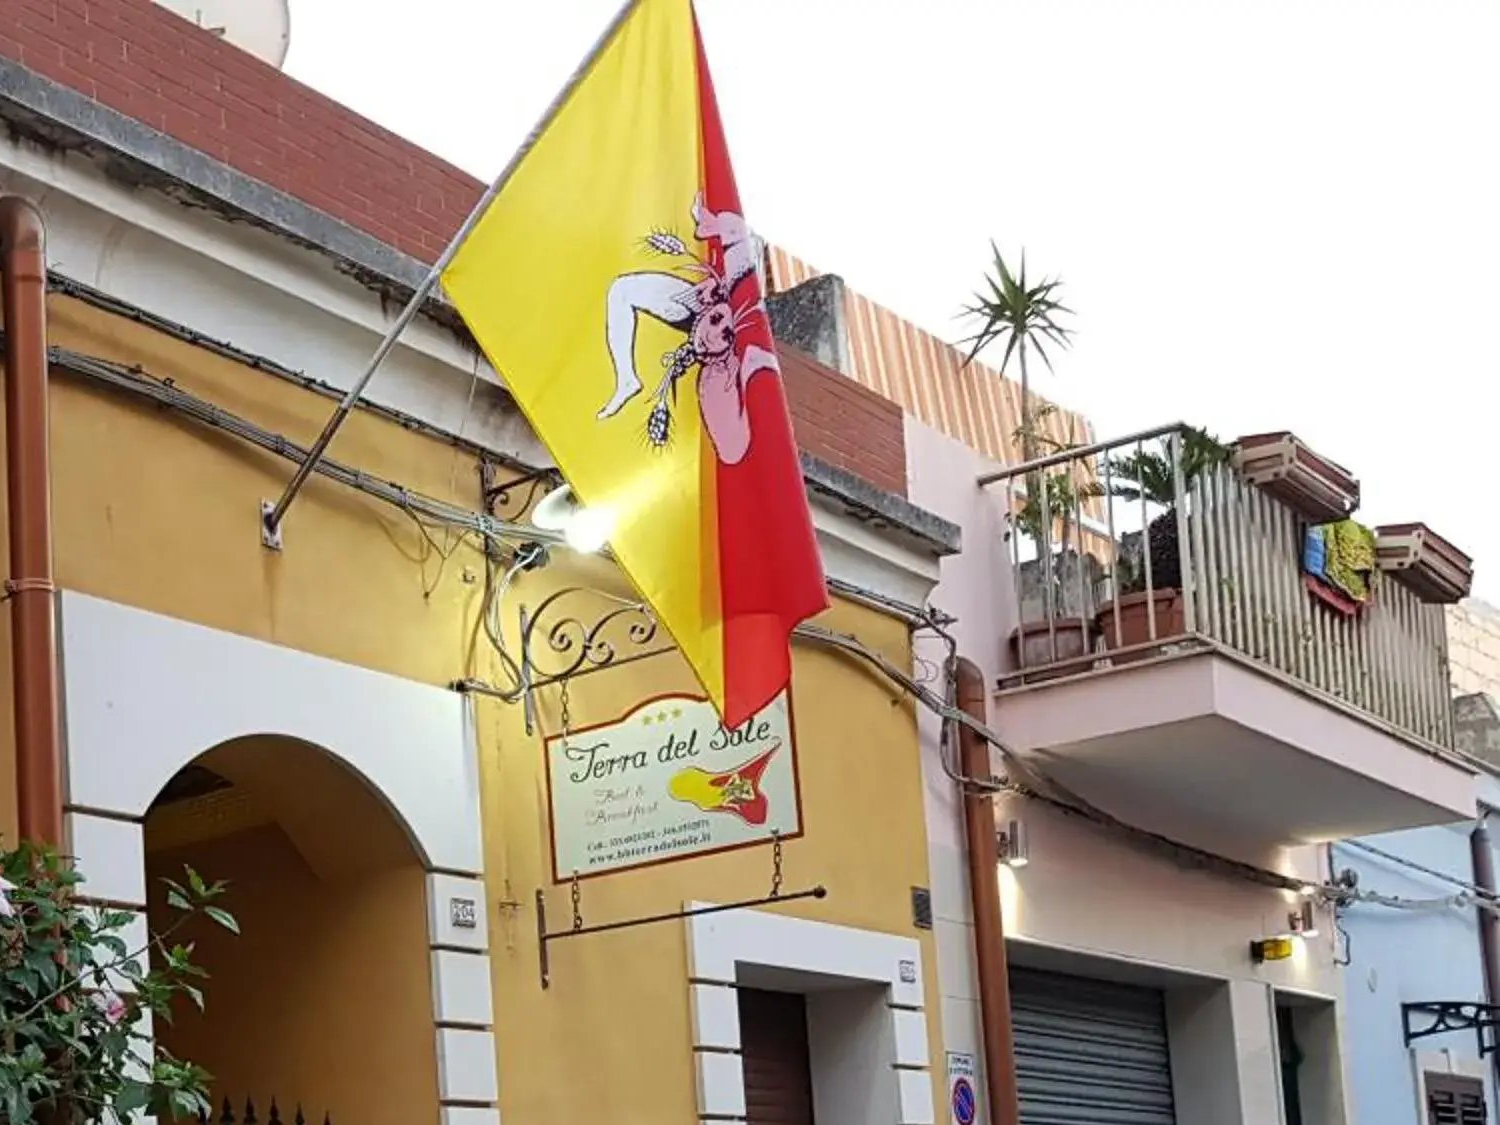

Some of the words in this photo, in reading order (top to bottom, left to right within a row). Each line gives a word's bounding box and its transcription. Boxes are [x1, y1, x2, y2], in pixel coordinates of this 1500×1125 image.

[565, 743, 647, 783] Terra
[657, 728, 700, 763] del
[709, 717, 771, 751] Sole
